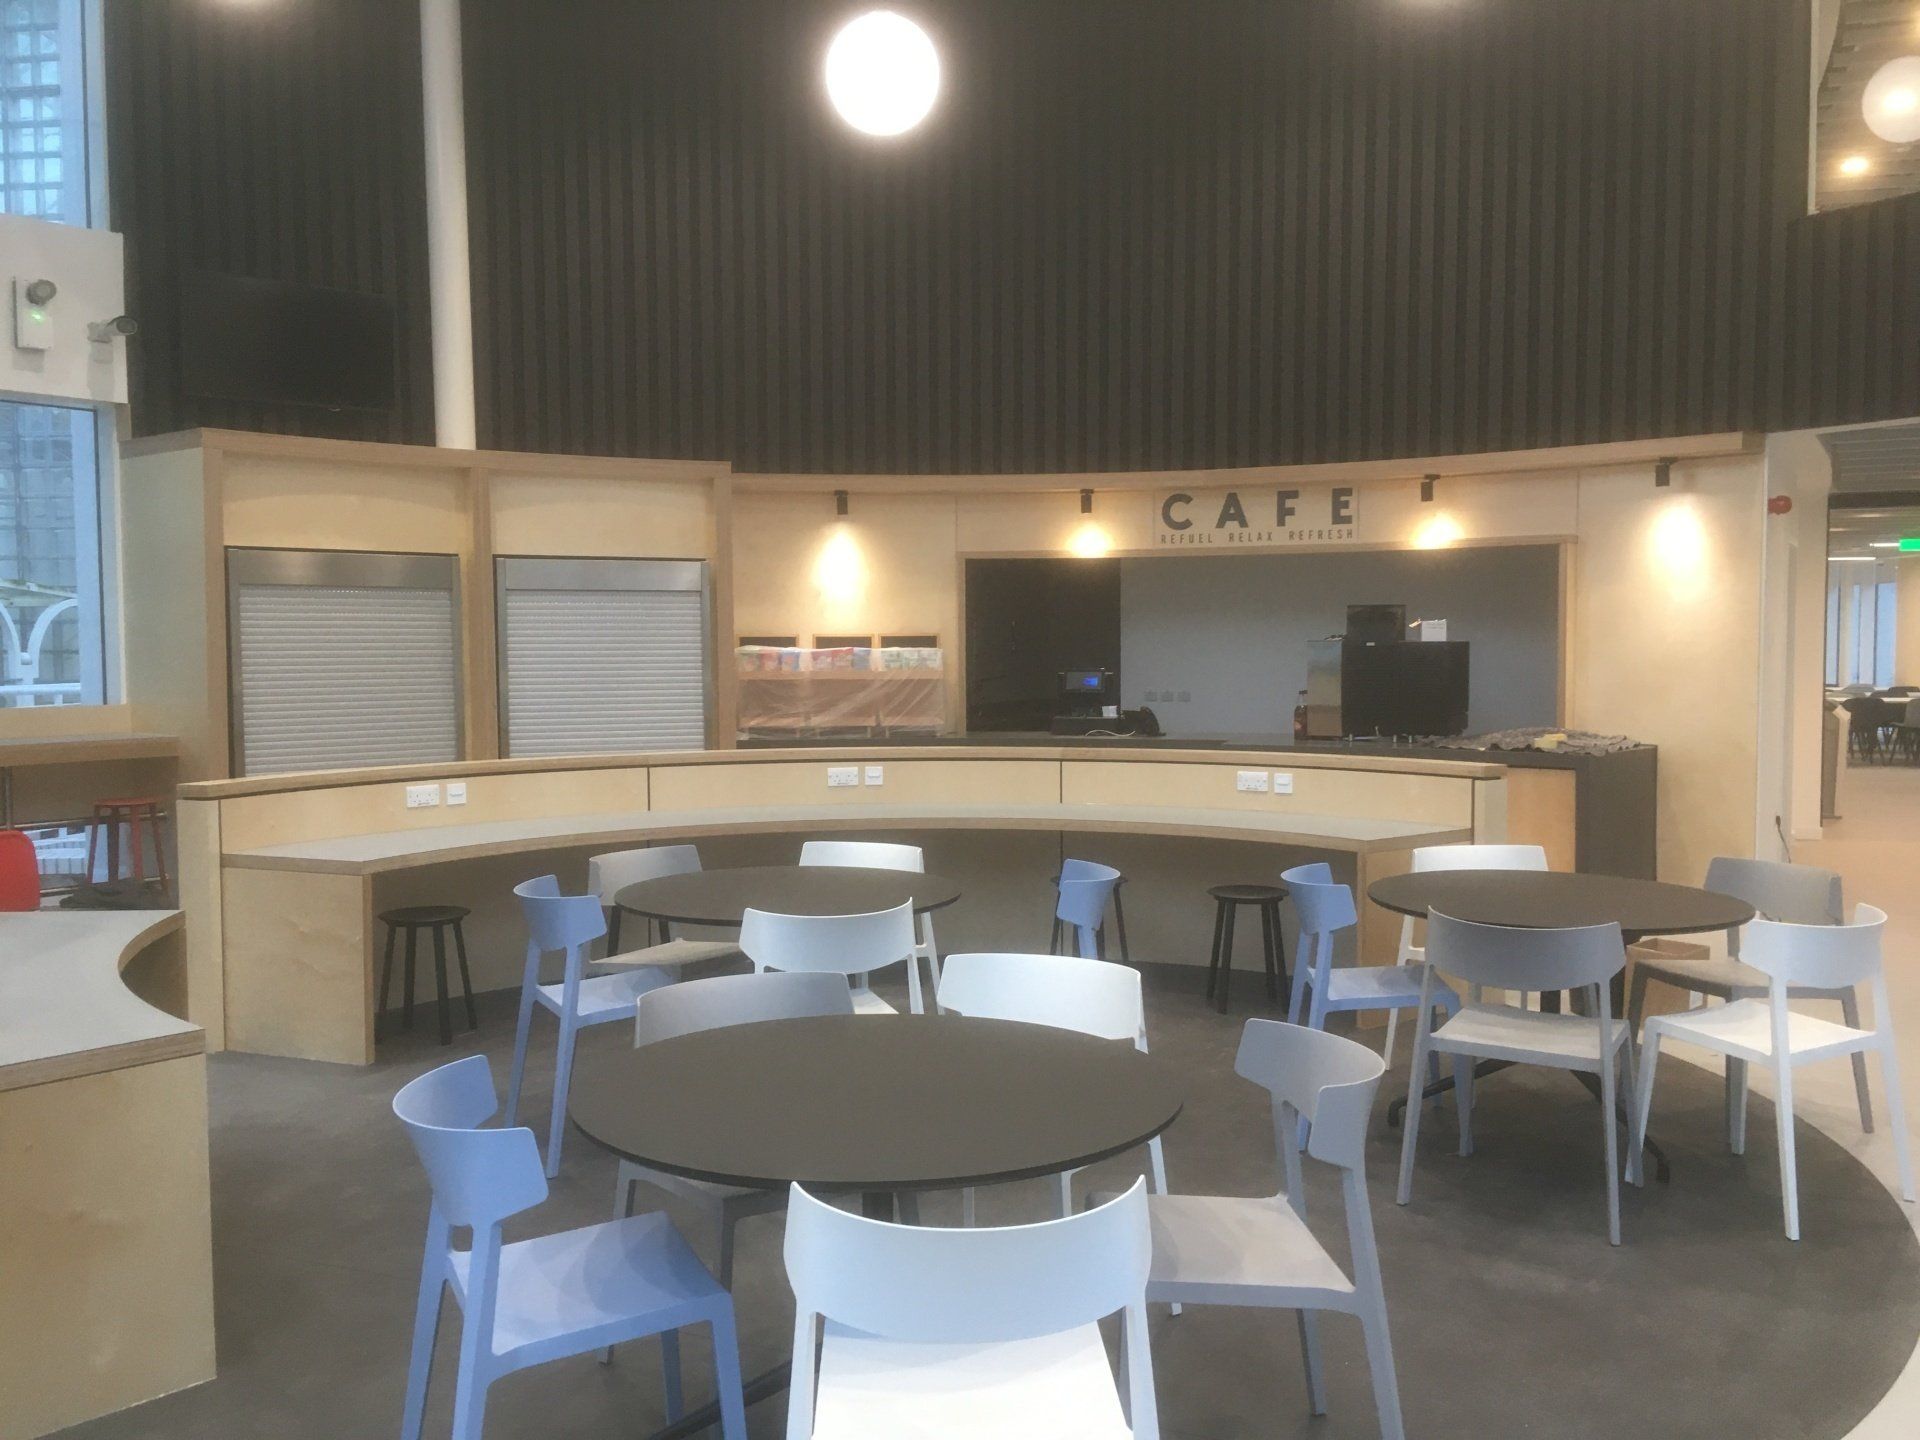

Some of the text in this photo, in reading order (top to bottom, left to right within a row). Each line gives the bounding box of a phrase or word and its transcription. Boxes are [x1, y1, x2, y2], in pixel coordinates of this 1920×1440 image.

[1161, 487, 1354, 531] CAFE
[1160, 528, 1353, 545] REFUEL RELAX REFRESH
